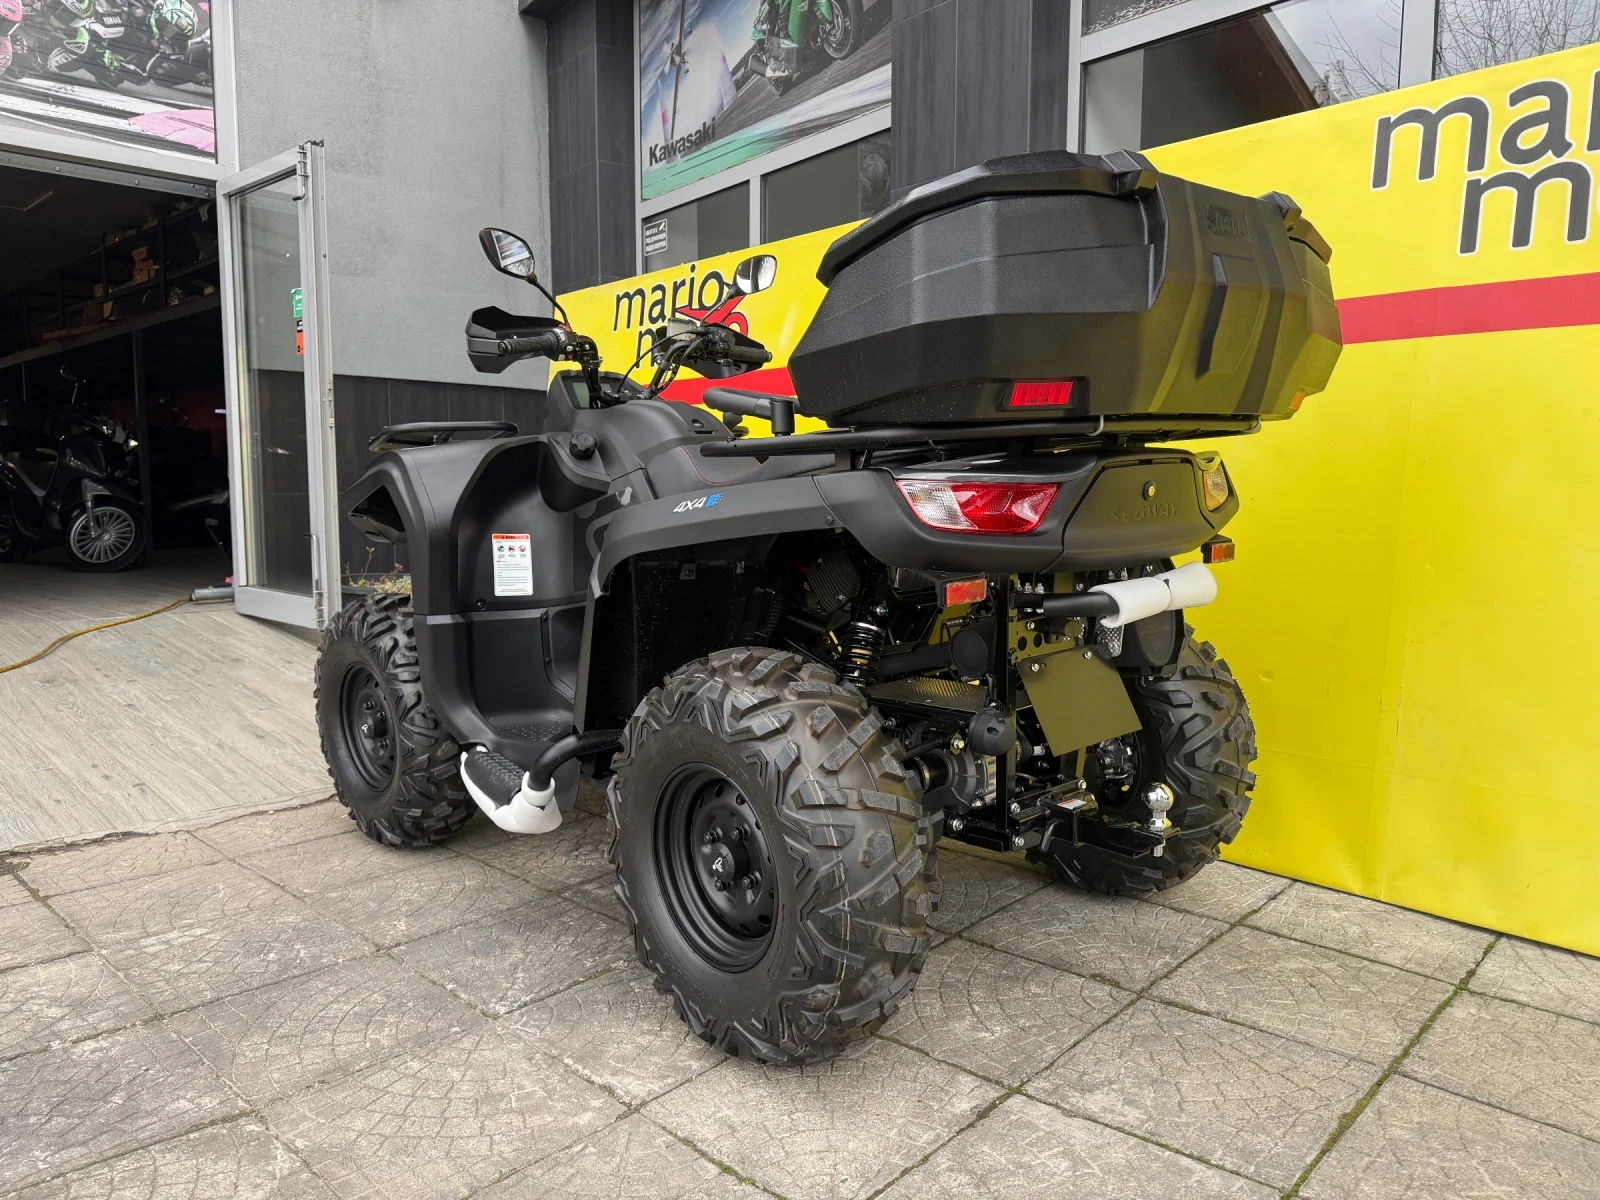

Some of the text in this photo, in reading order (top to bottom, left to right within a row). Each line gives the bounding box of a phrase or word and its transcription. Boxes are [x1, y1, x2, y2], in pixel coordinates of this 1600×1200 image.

[649, 116, 716, 167] Kawasaki
[1459, 161, 1600, 255] m
[613, 263, 725, 332] mario
[1109, 501, 1181, 524] SEGWAY
